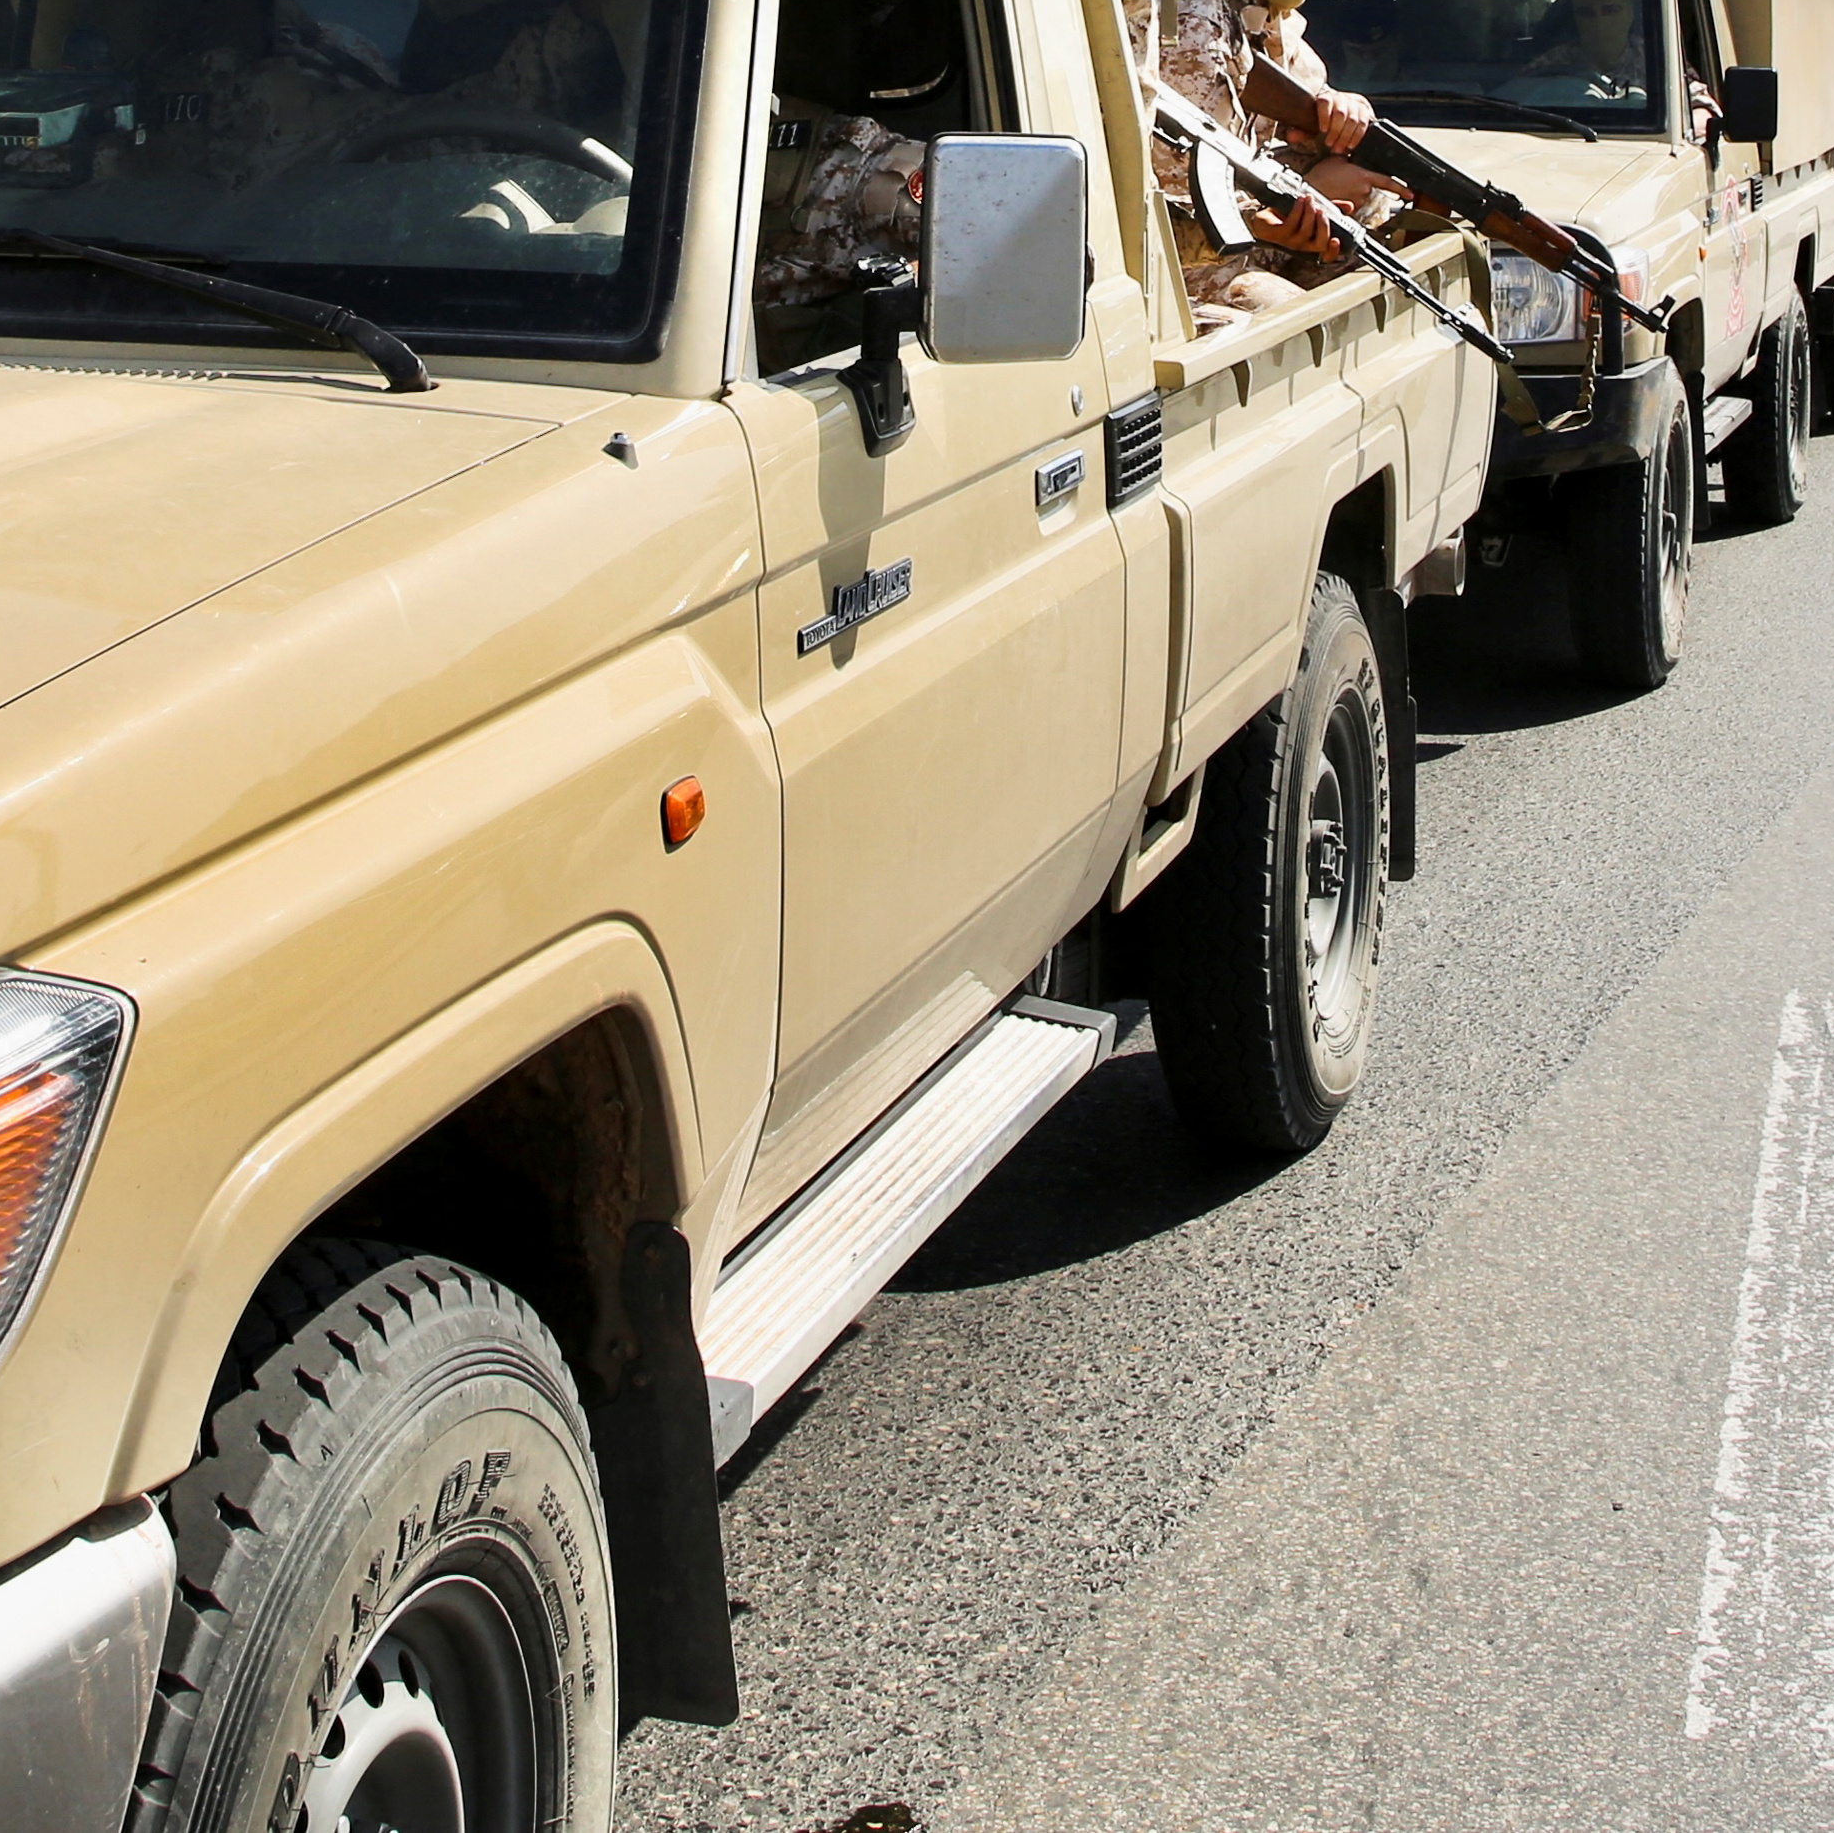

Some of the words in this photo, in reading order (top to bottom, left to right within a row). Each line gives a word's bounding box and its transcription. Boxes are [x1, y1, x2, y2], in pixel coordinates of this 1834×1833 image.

[806, 620, 835, 646] TOYOTA
[836, 584, 867, 626] LAND
[867, 563, 911, 612] CRUISER
